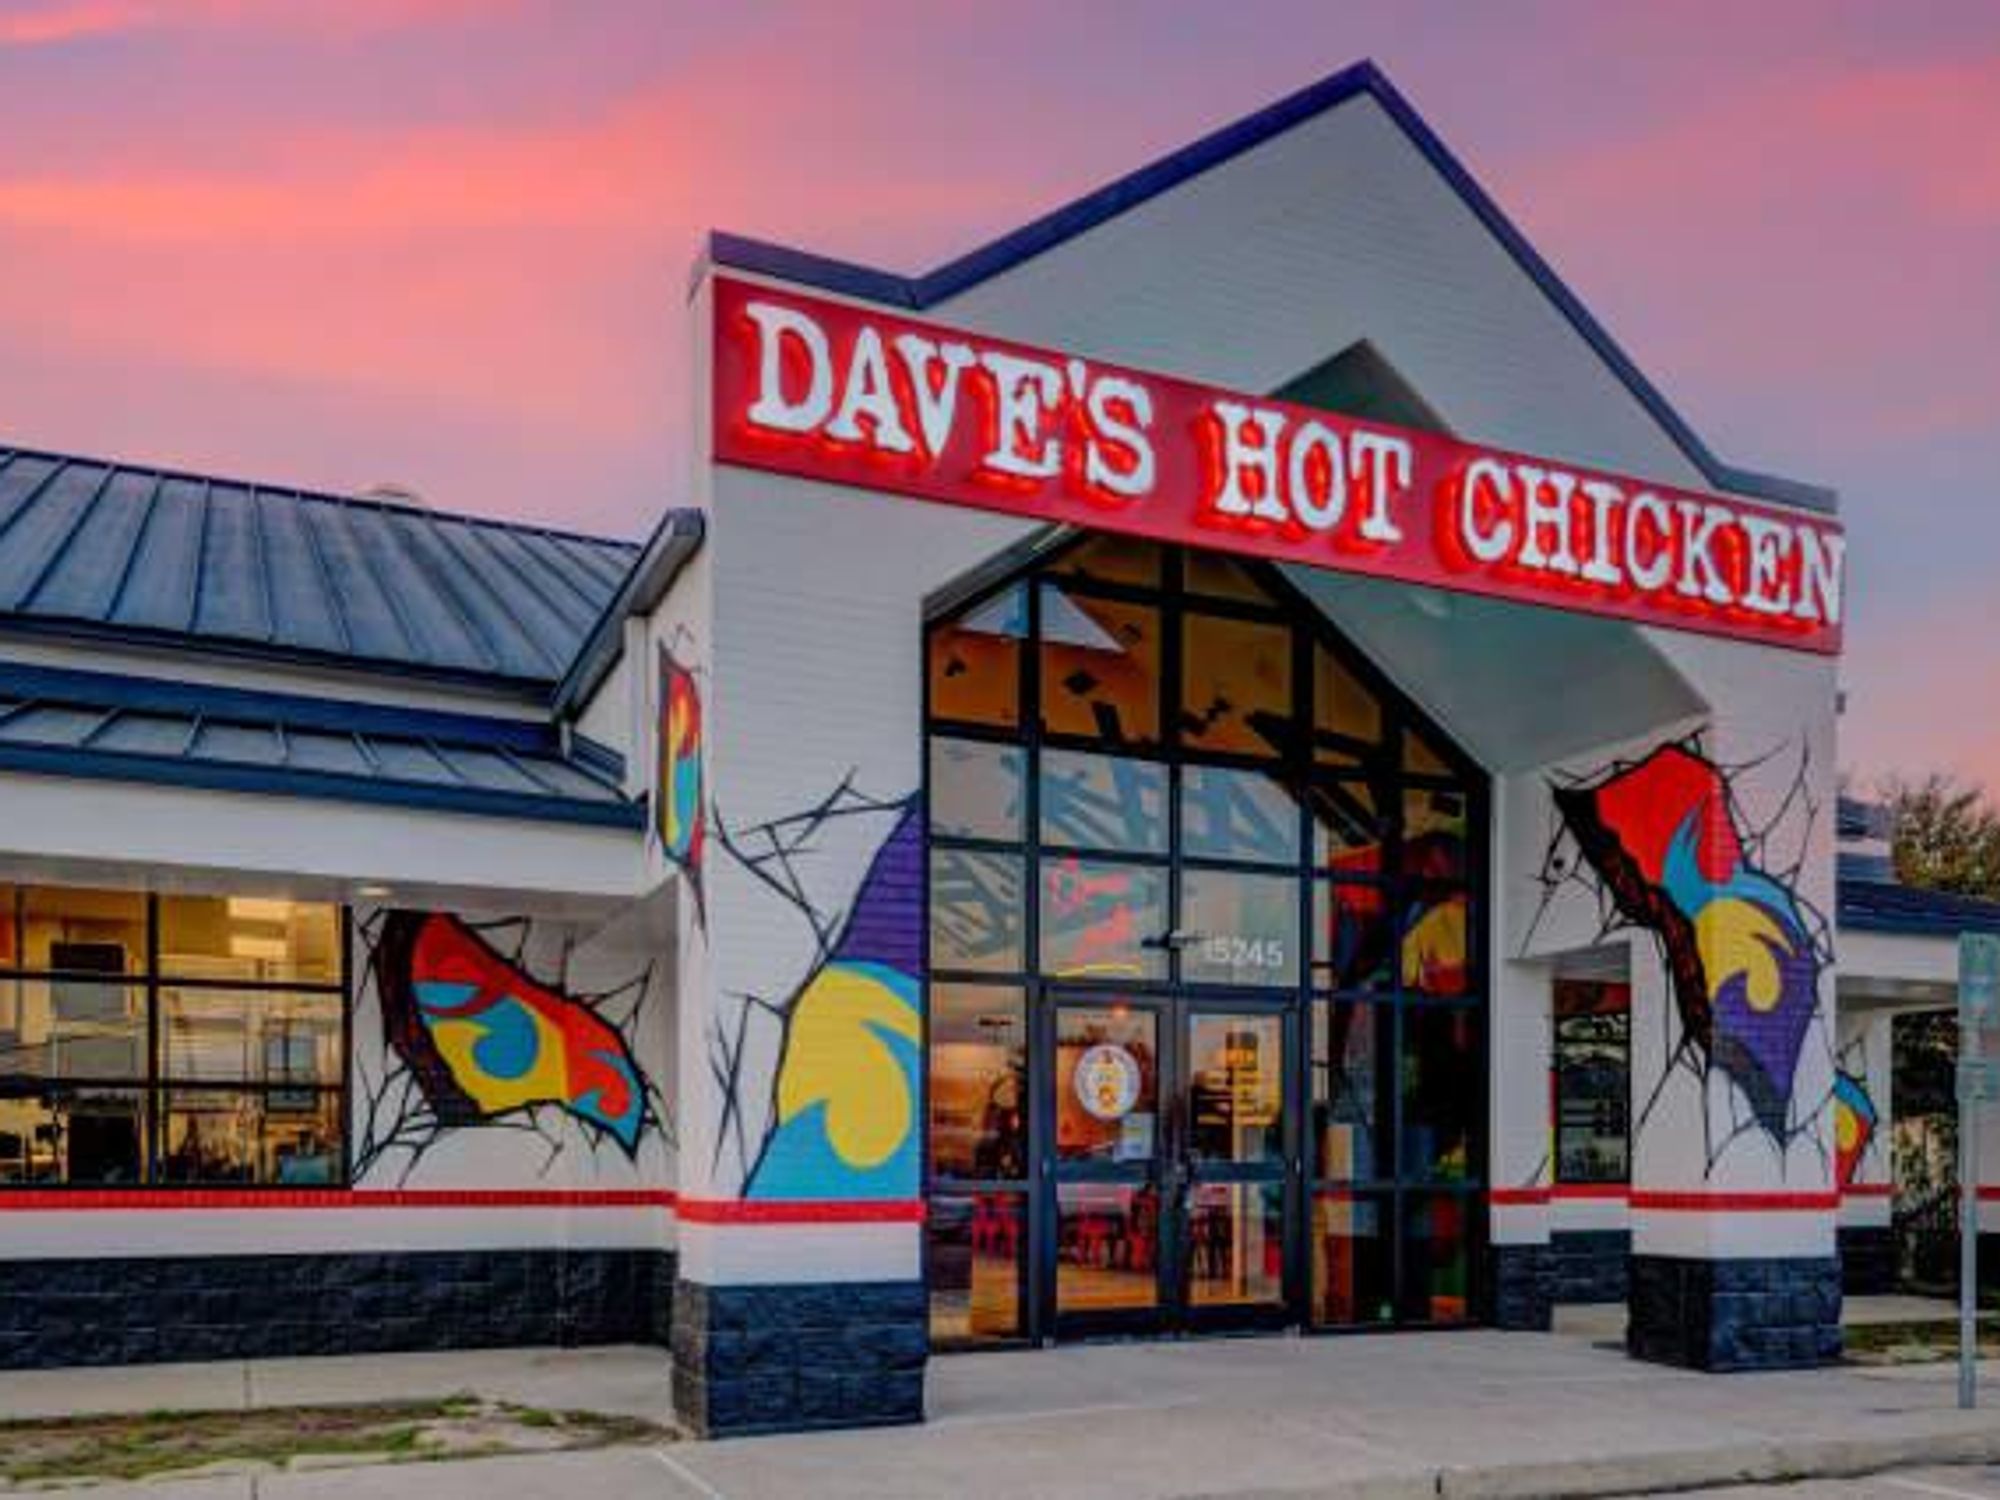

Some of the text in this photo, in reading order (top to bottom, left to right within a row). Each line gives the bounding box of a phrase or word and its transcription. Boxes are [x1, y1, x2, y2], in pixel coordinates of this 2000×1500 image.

[746, 302, 1846, 624] DAVE'S HOT CHICKEN
